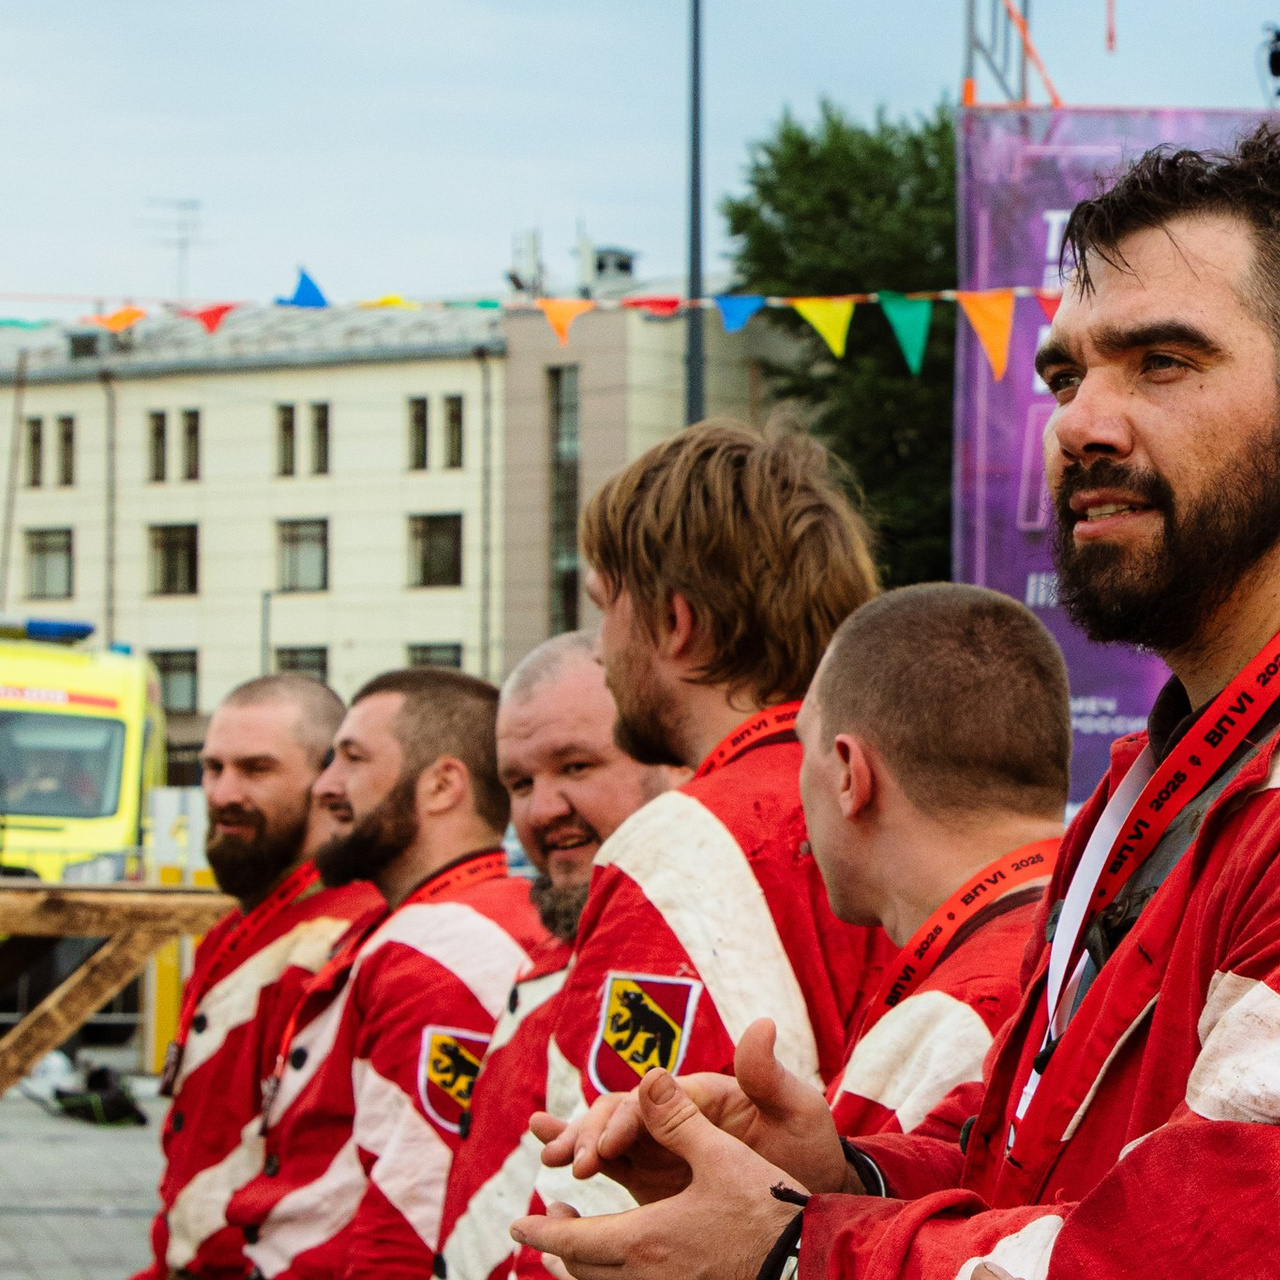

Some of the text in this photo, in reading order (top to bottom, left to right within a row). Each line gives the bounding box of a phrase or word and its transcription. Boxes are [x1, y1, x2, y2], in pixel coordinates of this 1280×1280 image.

[1203, 714, 1236, 749] ВП
[1228, 691, 1255, 714] VI
[1107, 770, 1187, 875] ВП VI 2025
[960, 853, 1044, 907] ВП VI 2025
[884, 924, 943, 1008] ВП VI 2025
